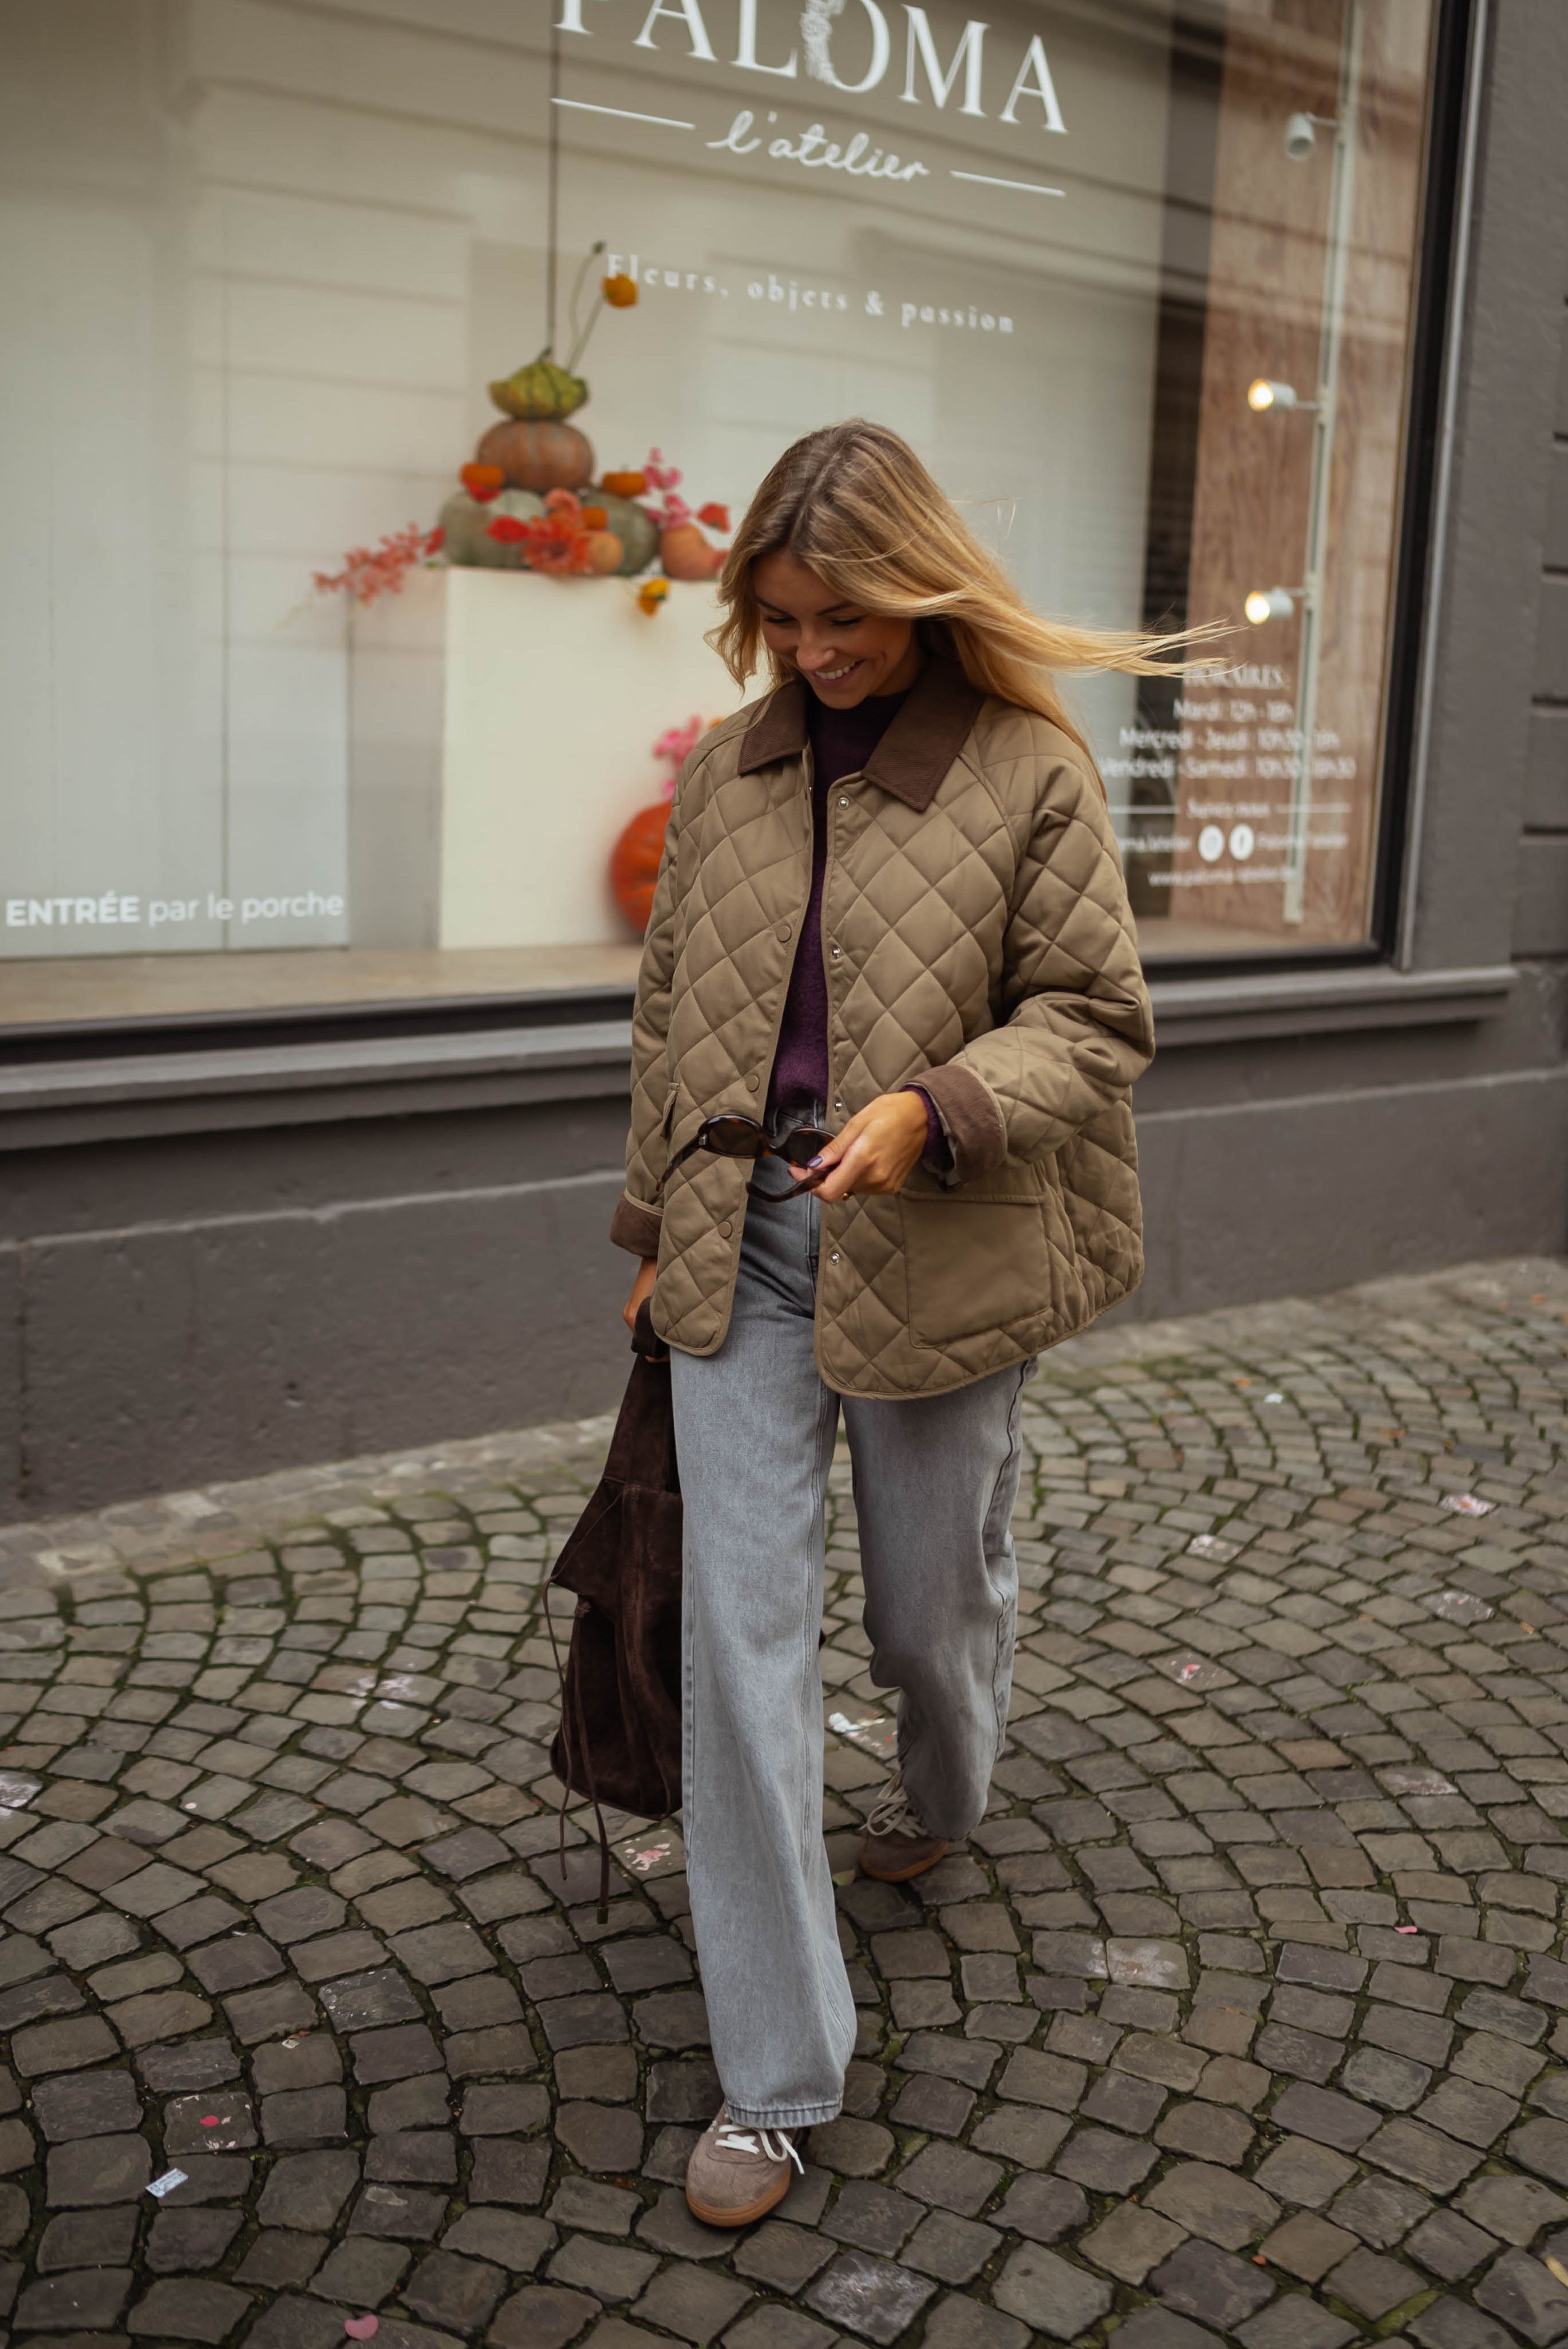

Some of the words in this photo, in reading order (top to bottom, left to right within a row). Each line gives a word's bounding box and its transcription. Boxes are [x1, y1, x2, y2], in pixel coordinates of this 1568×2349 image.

[705, 110, 930, 182] l'atelier
[864, 290, 884, 316] &
[900, 302, 1014, 333] passion
[6, 889, 140, 927] ENTRÉE
[149, 897, 199, 928] par
[207, 892, 234, 920] le
[241, 889, 344, 924] porche
